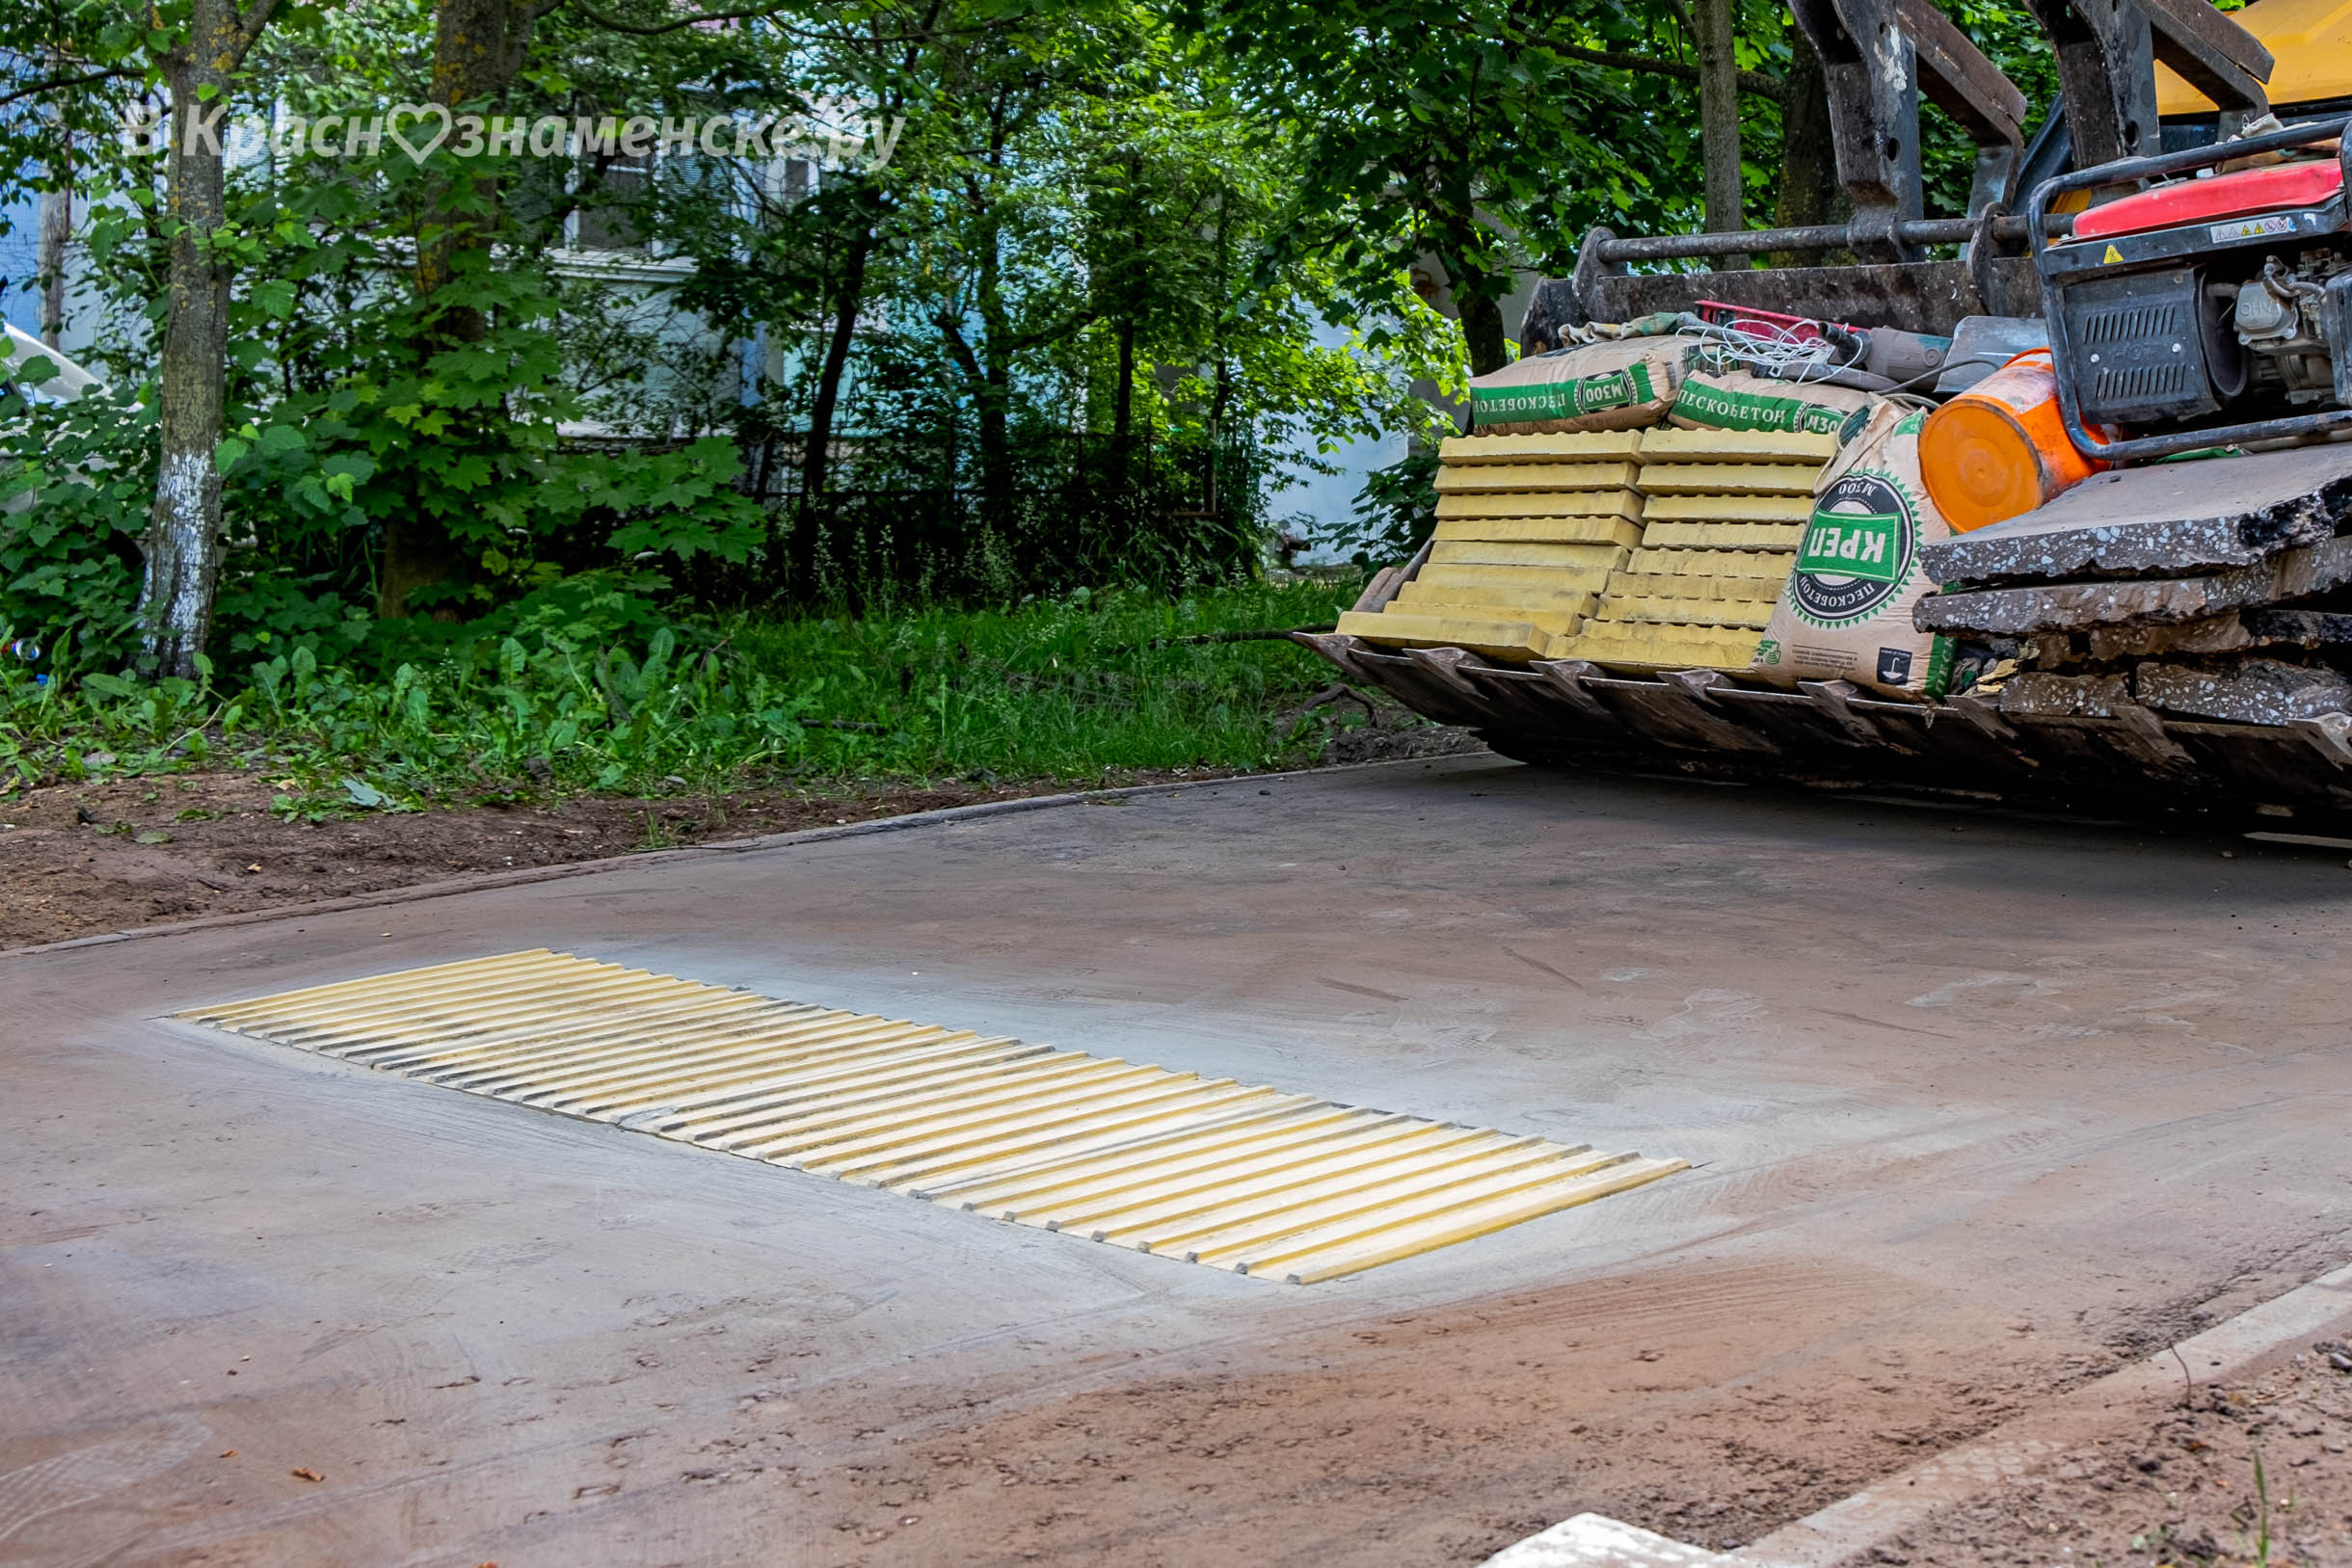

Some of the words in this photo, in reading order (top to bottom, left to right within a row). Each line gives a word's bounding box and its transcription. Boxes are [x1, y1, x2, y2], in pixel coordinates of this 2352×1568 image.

[1676, 389, 1786, 423] ПЕСКОБЕТОН
[1806, 414, 1838, 433] М30
[1808, 528, 1886, 563] КРЕП
